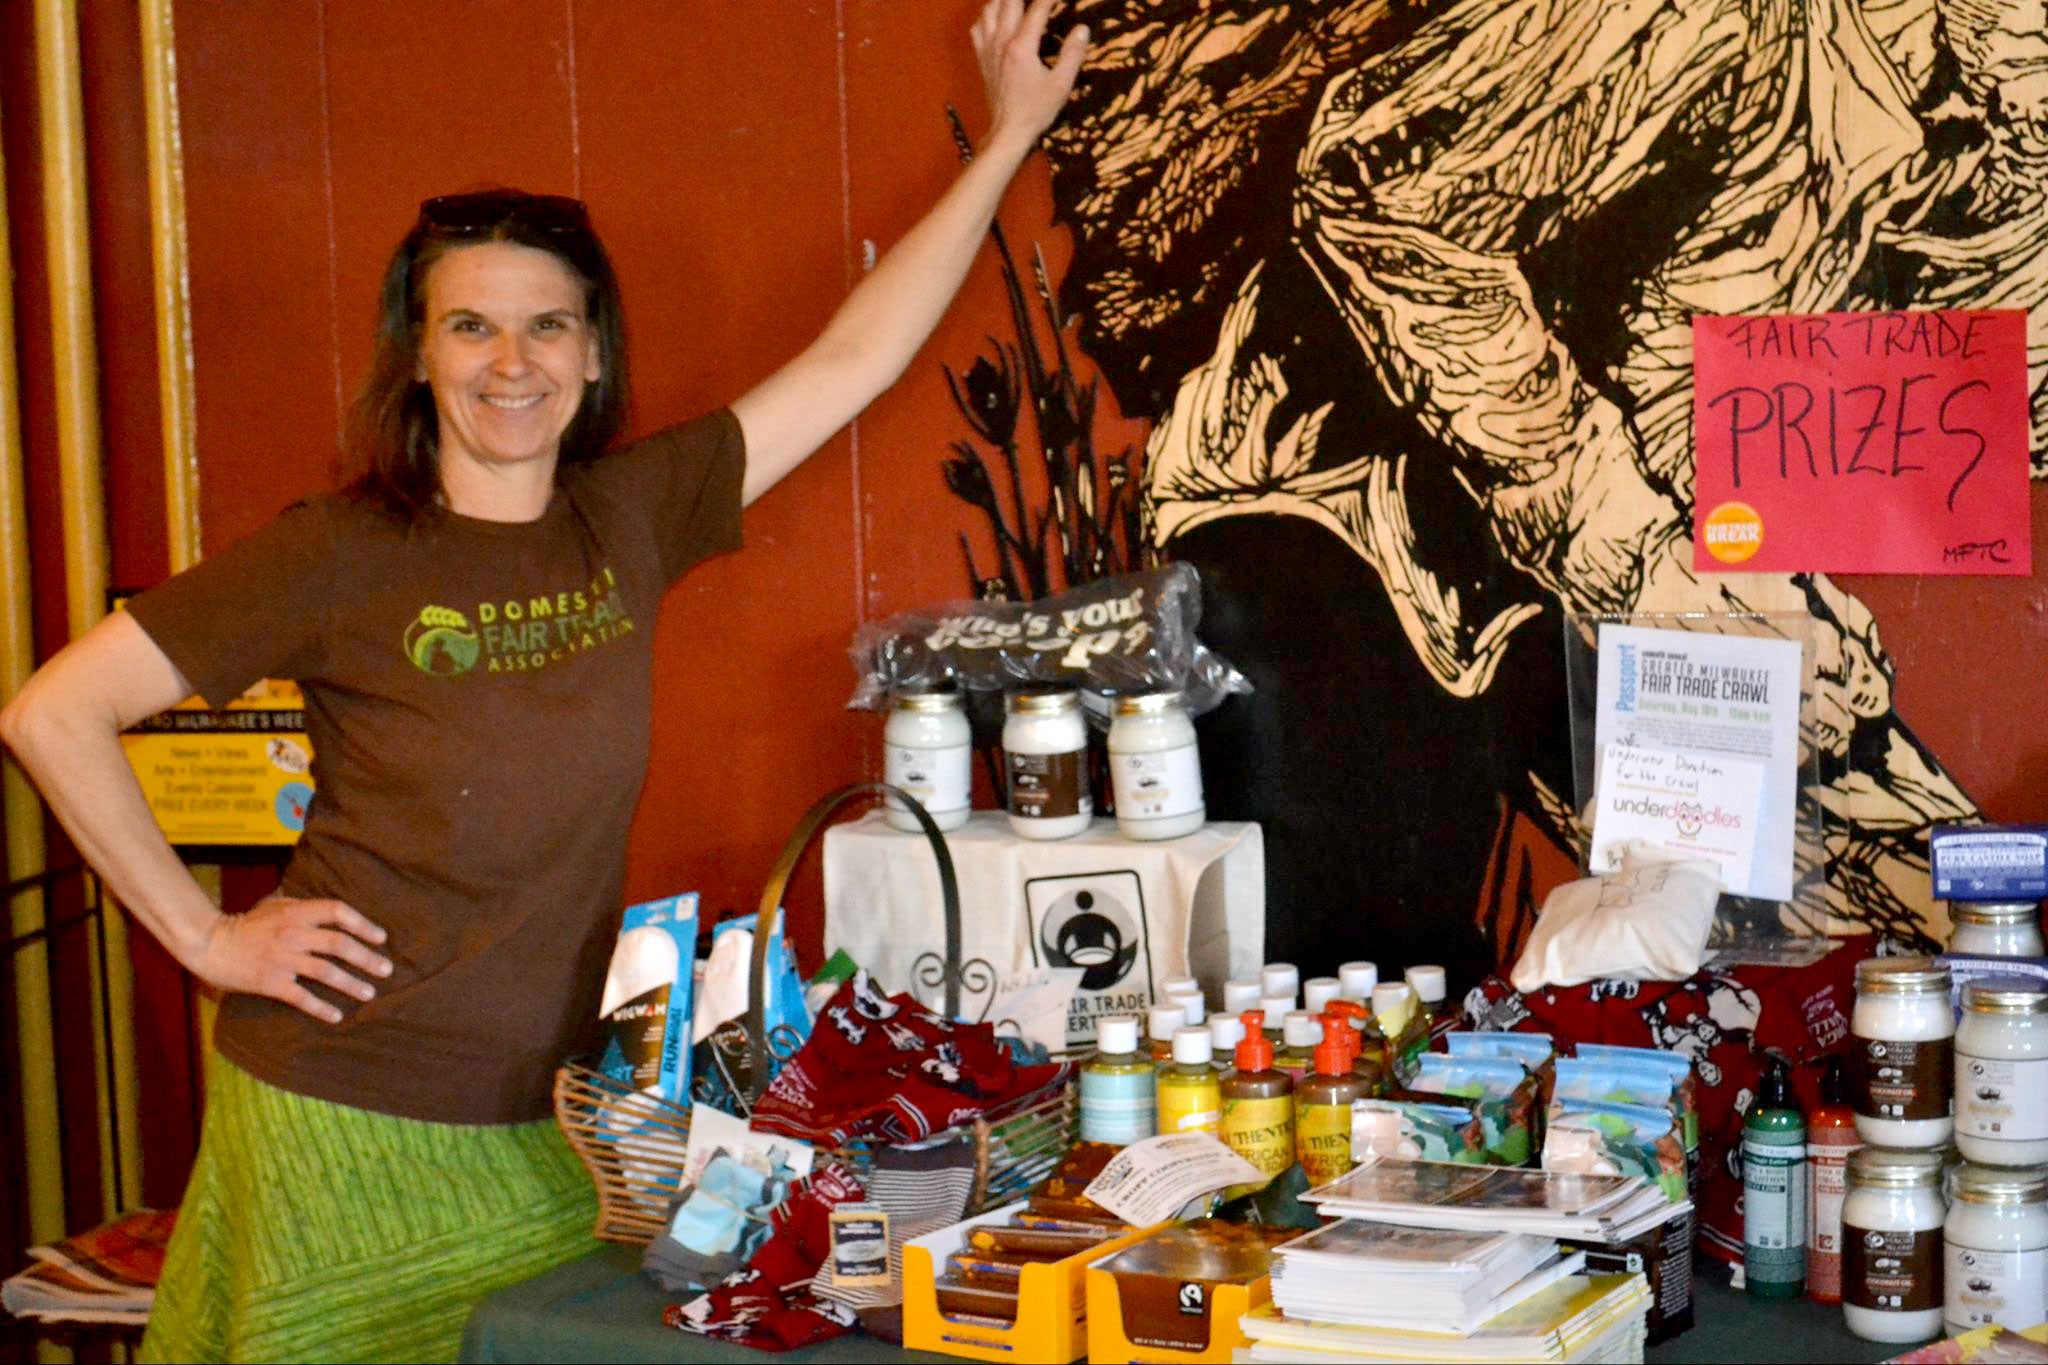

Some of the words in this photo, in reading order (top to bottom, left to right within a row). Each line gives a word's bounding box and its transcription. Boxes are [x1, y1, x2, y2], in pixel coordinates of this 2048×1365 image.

[1726, 316, 1839, 359] FAIR
[1841, 312, 1998, 360] TRADE
[1707, 372, 1993, 514] PRIZES
[1057, 587, 1146, 638] your
[482, 621, 549, 654] FAIR
[1615, 643, 1637, 713] Passport
[1641, 659, 1694, 678] GREATER
[1700, 664, 1771, 685] MILWAUKEE
[1640, 673, 1671, 695] FAIR
[1676, 676, 1718, 700] TRADE
[1721, 680, 1770, 705] CRAWL
[1612, 797, 1742, 830] underdoodles
[1070, 997, 1089, 1014] IR
[1094, 992, 1147, 1013] TRADE
